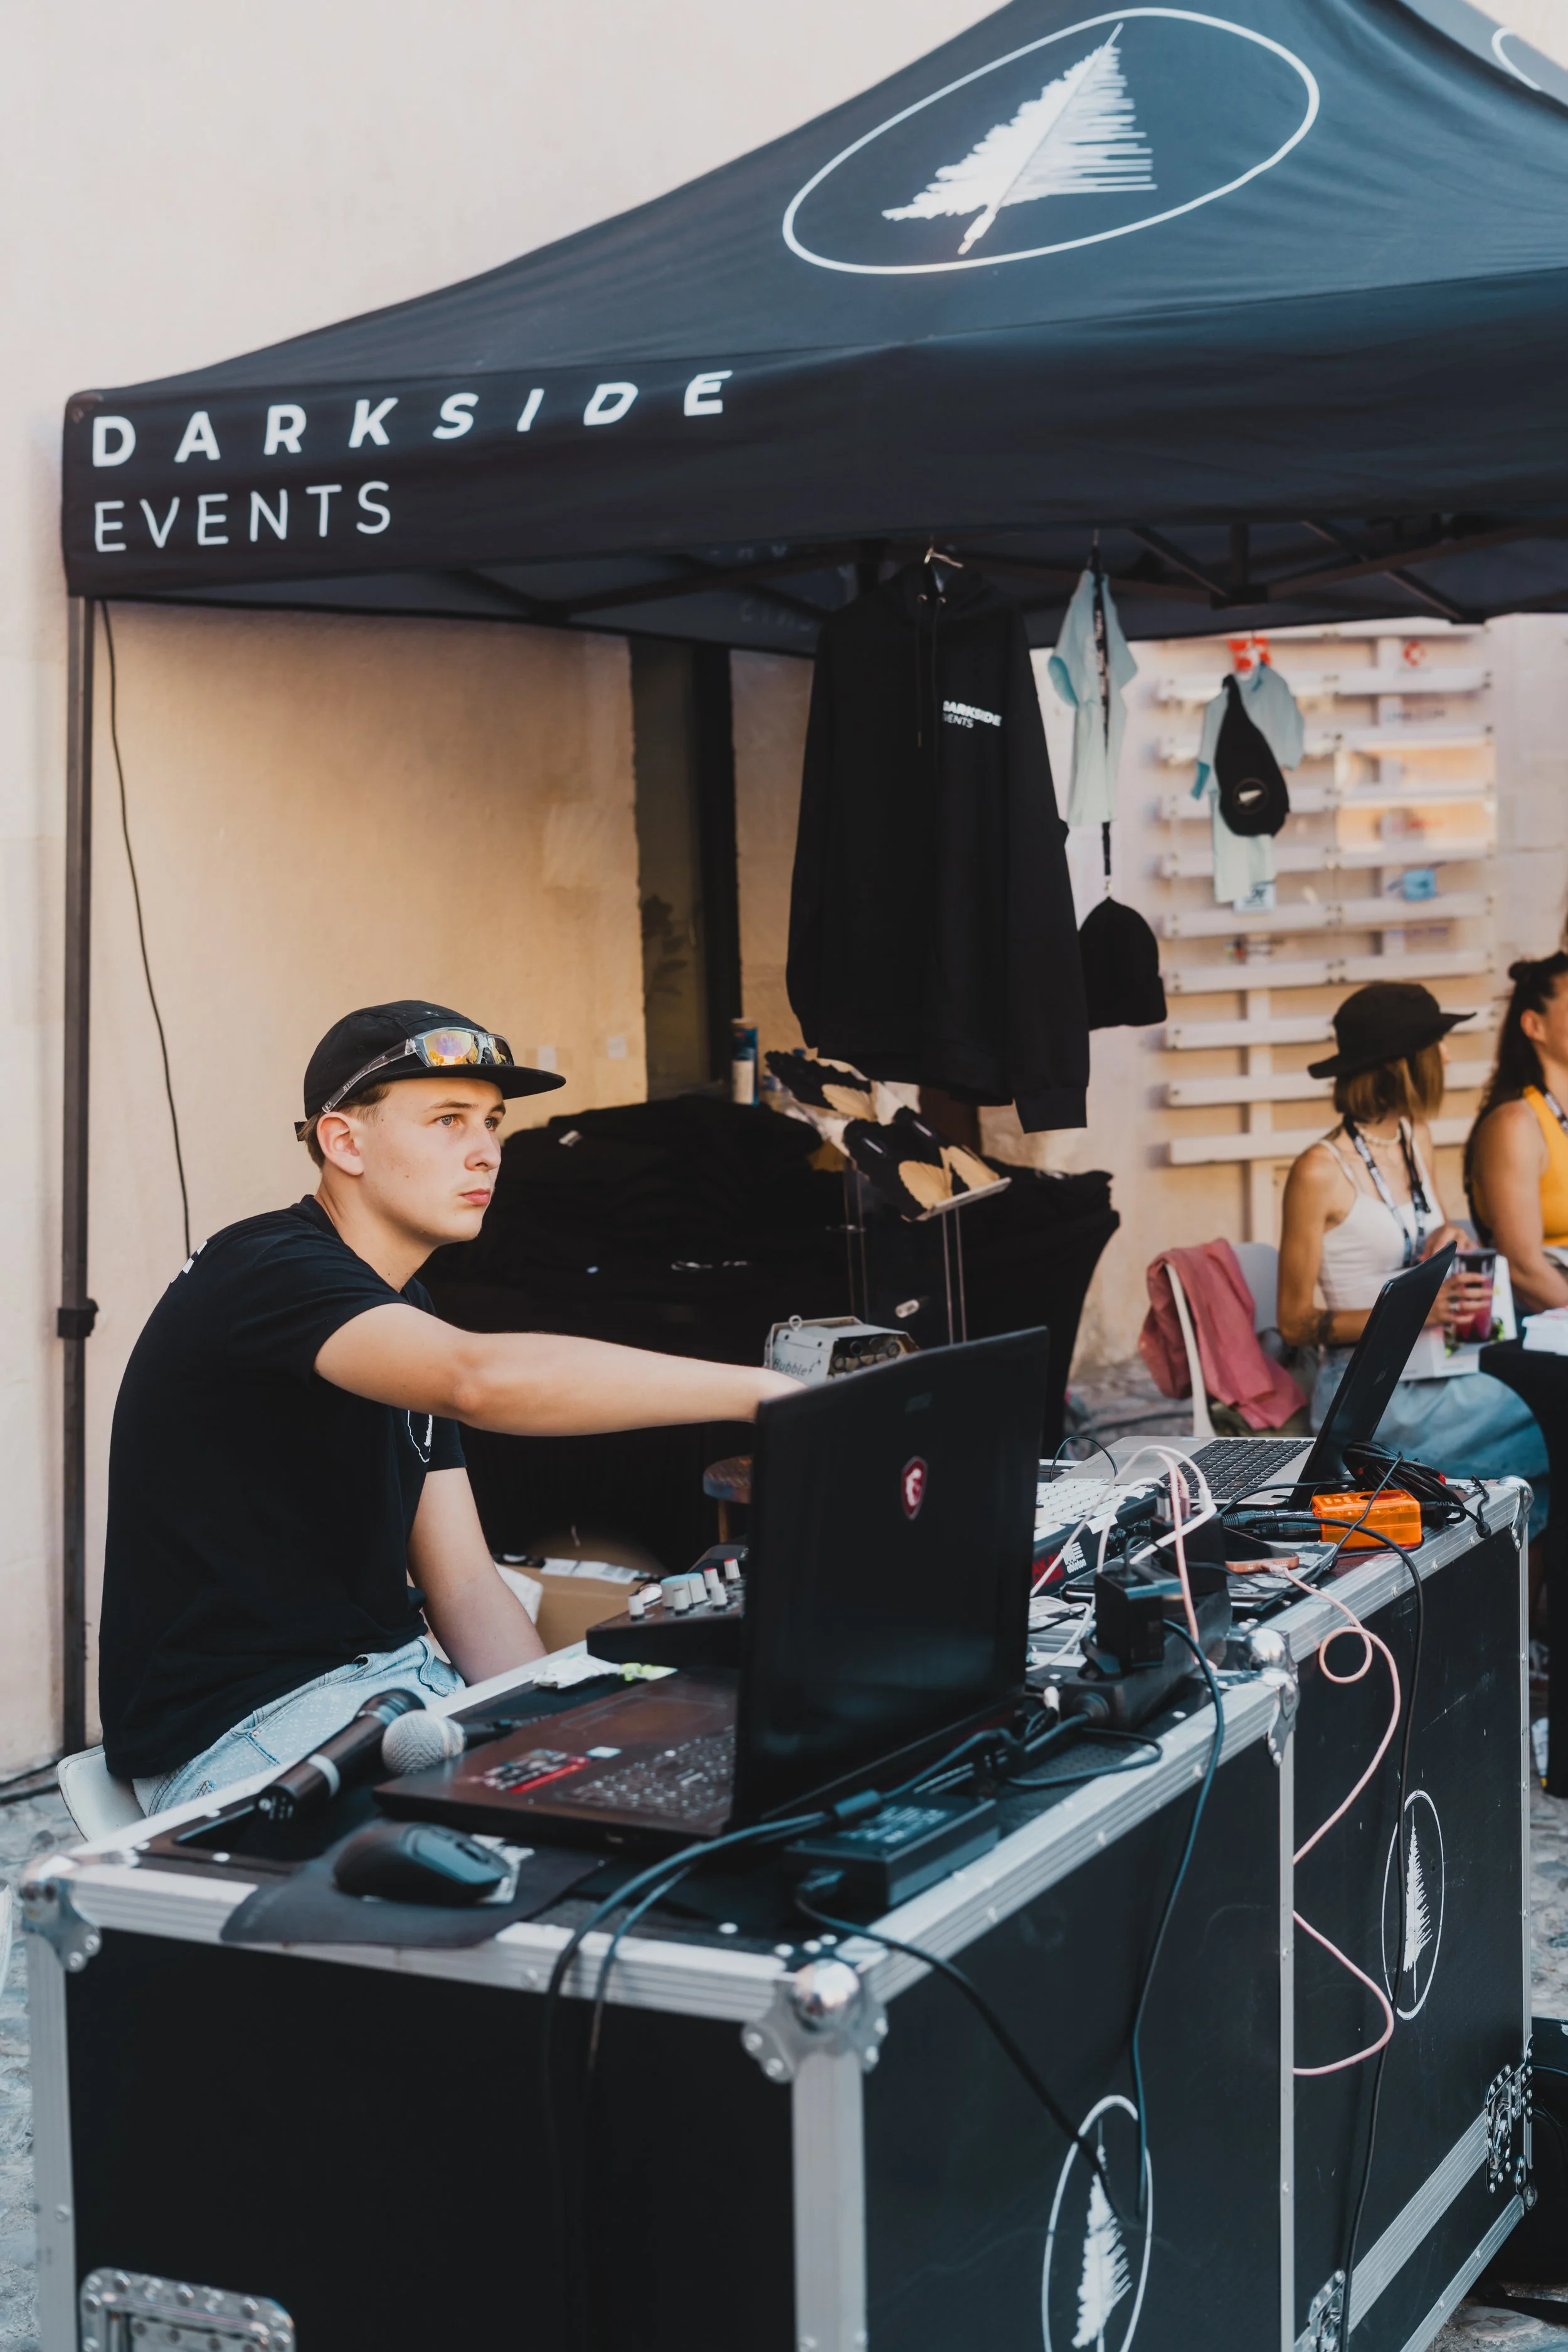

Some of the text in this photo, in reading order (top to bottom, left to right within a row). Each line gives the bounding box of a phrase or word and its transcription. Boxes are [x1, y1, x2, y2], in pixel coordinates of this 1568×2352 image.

[92, 369, 733, 468] DARKSIDE
[94, 480, 391, 553] EVENTS
[1066, 1558, 1087, 1574] ableton
